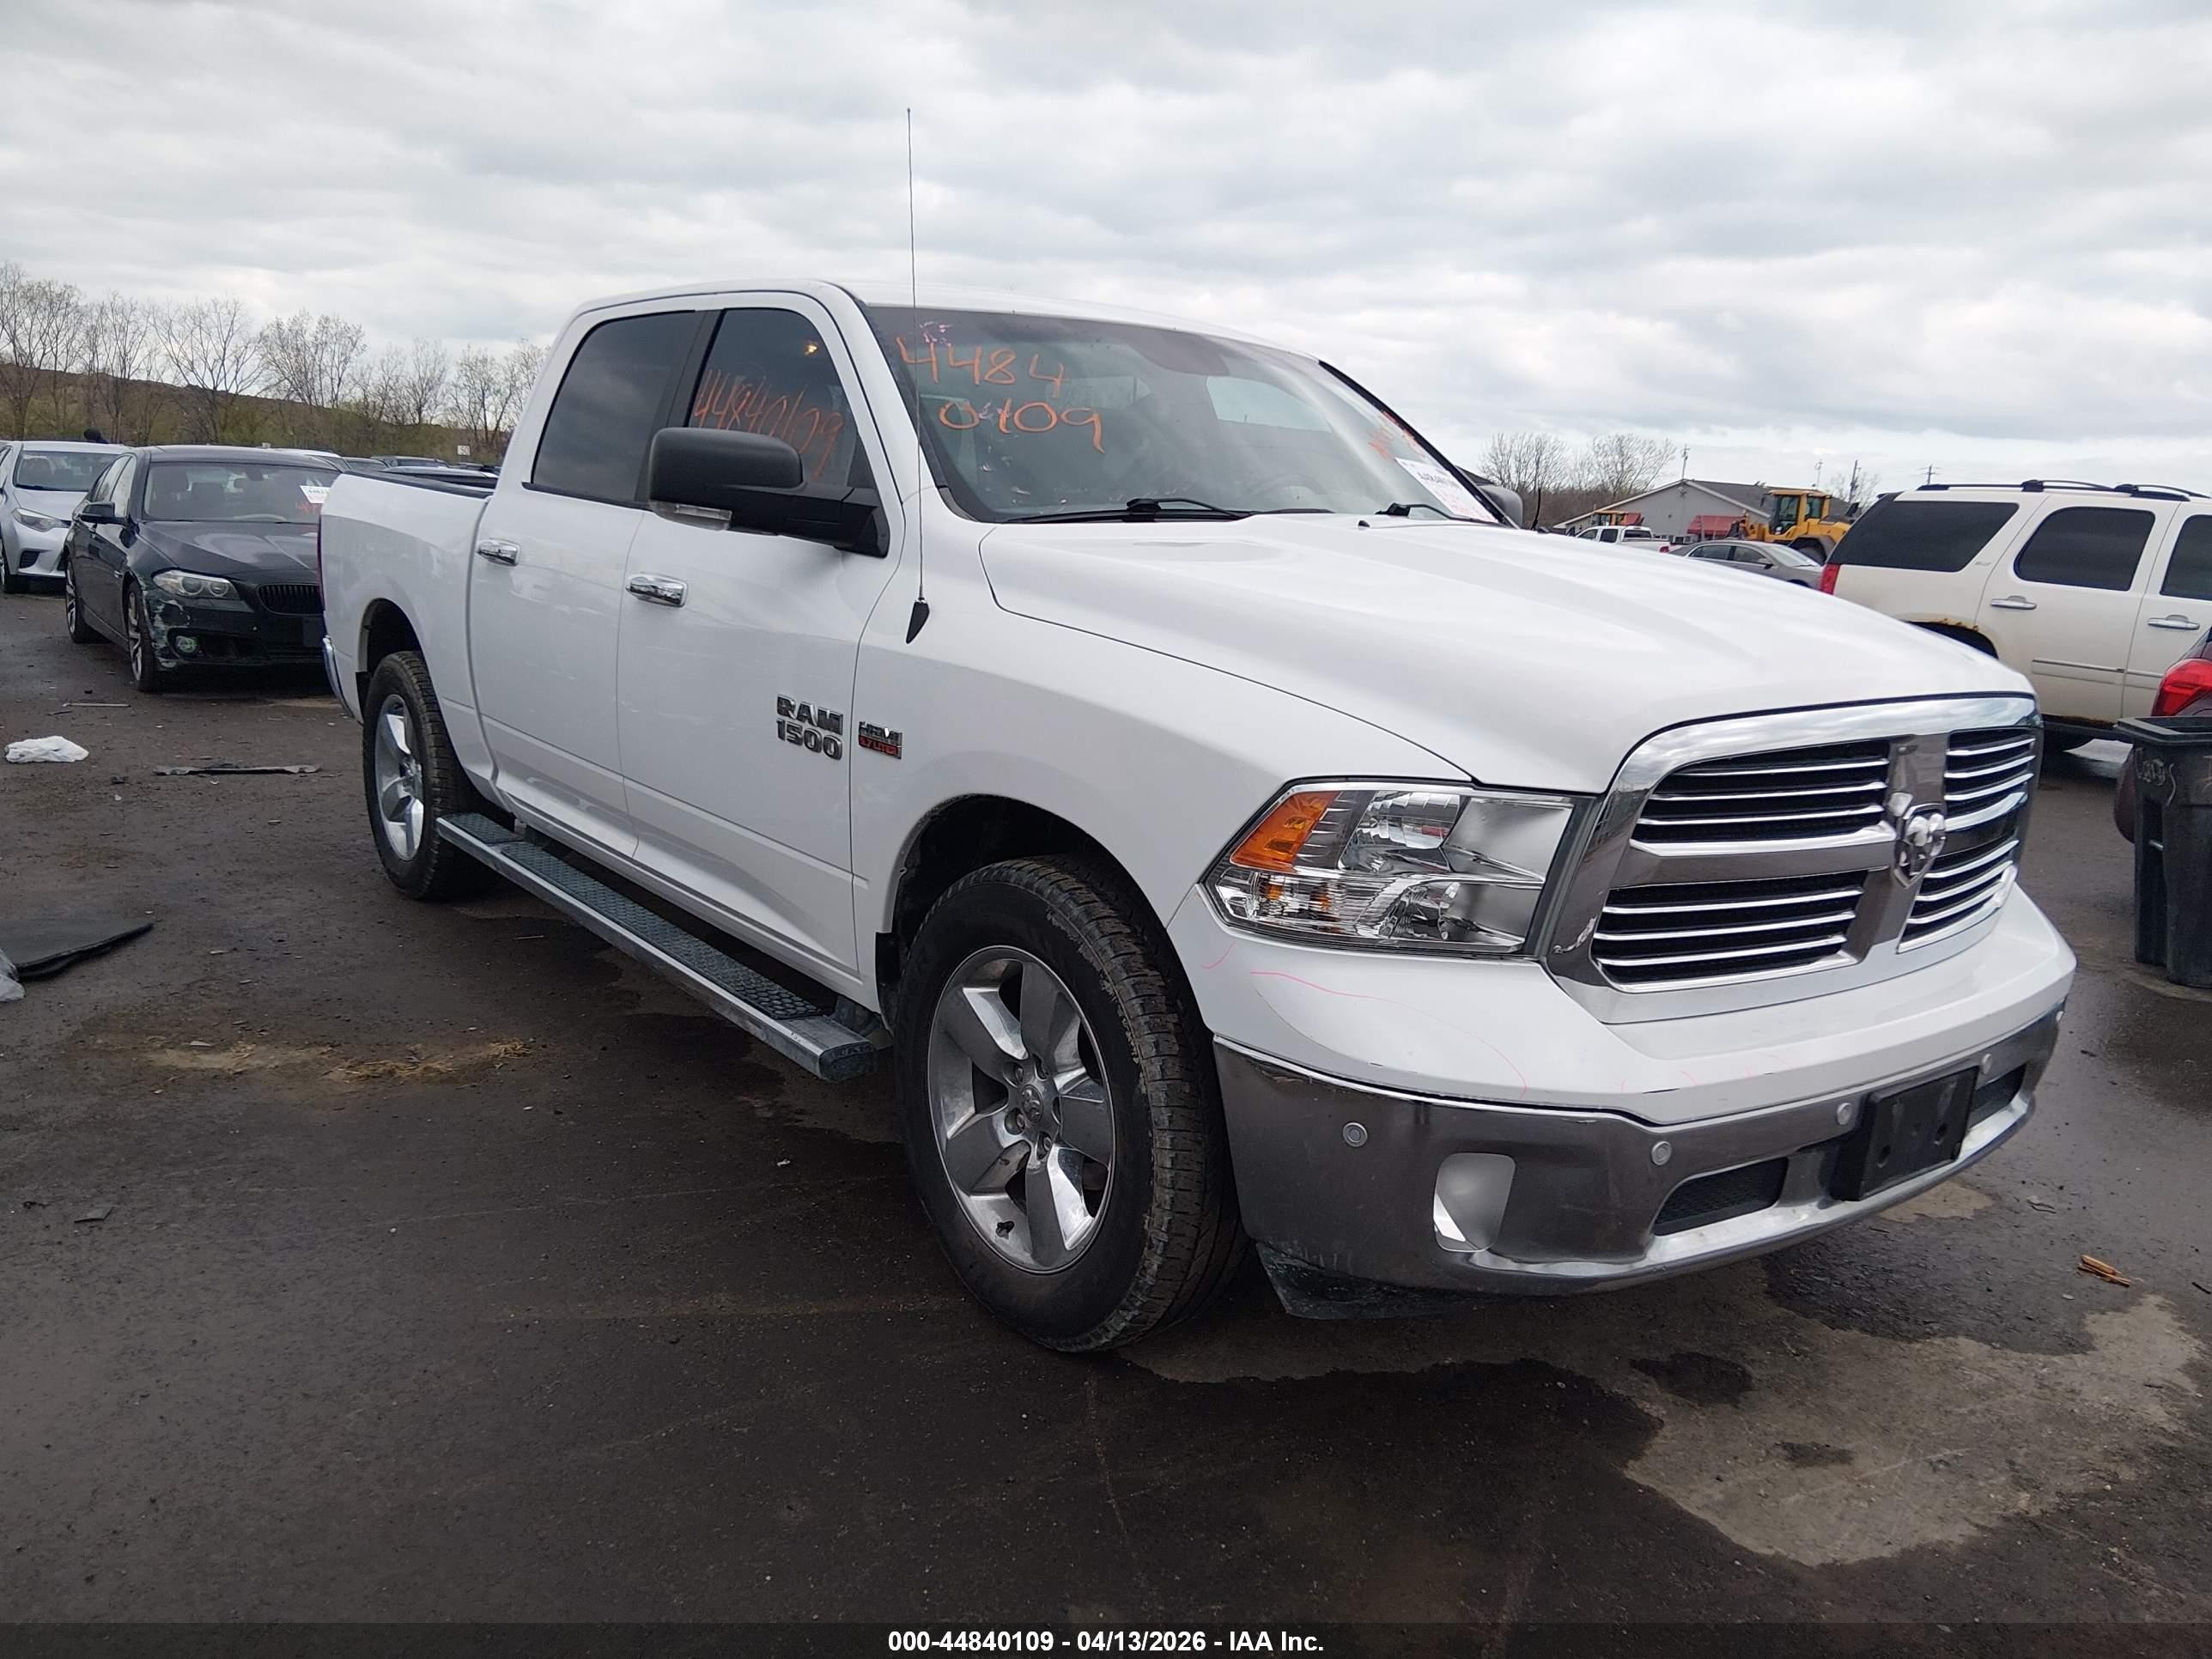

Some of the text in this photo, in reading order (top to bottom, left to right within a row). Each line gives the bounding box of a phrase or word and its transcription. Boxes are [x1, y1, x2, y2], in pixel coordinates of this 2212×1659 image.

[896, 336, 1066, 398] 4484
[939, 398, 1106, 454] 0109
[776, 694, 844, 736] RAM
[776, 718, 843, 761] 1500
